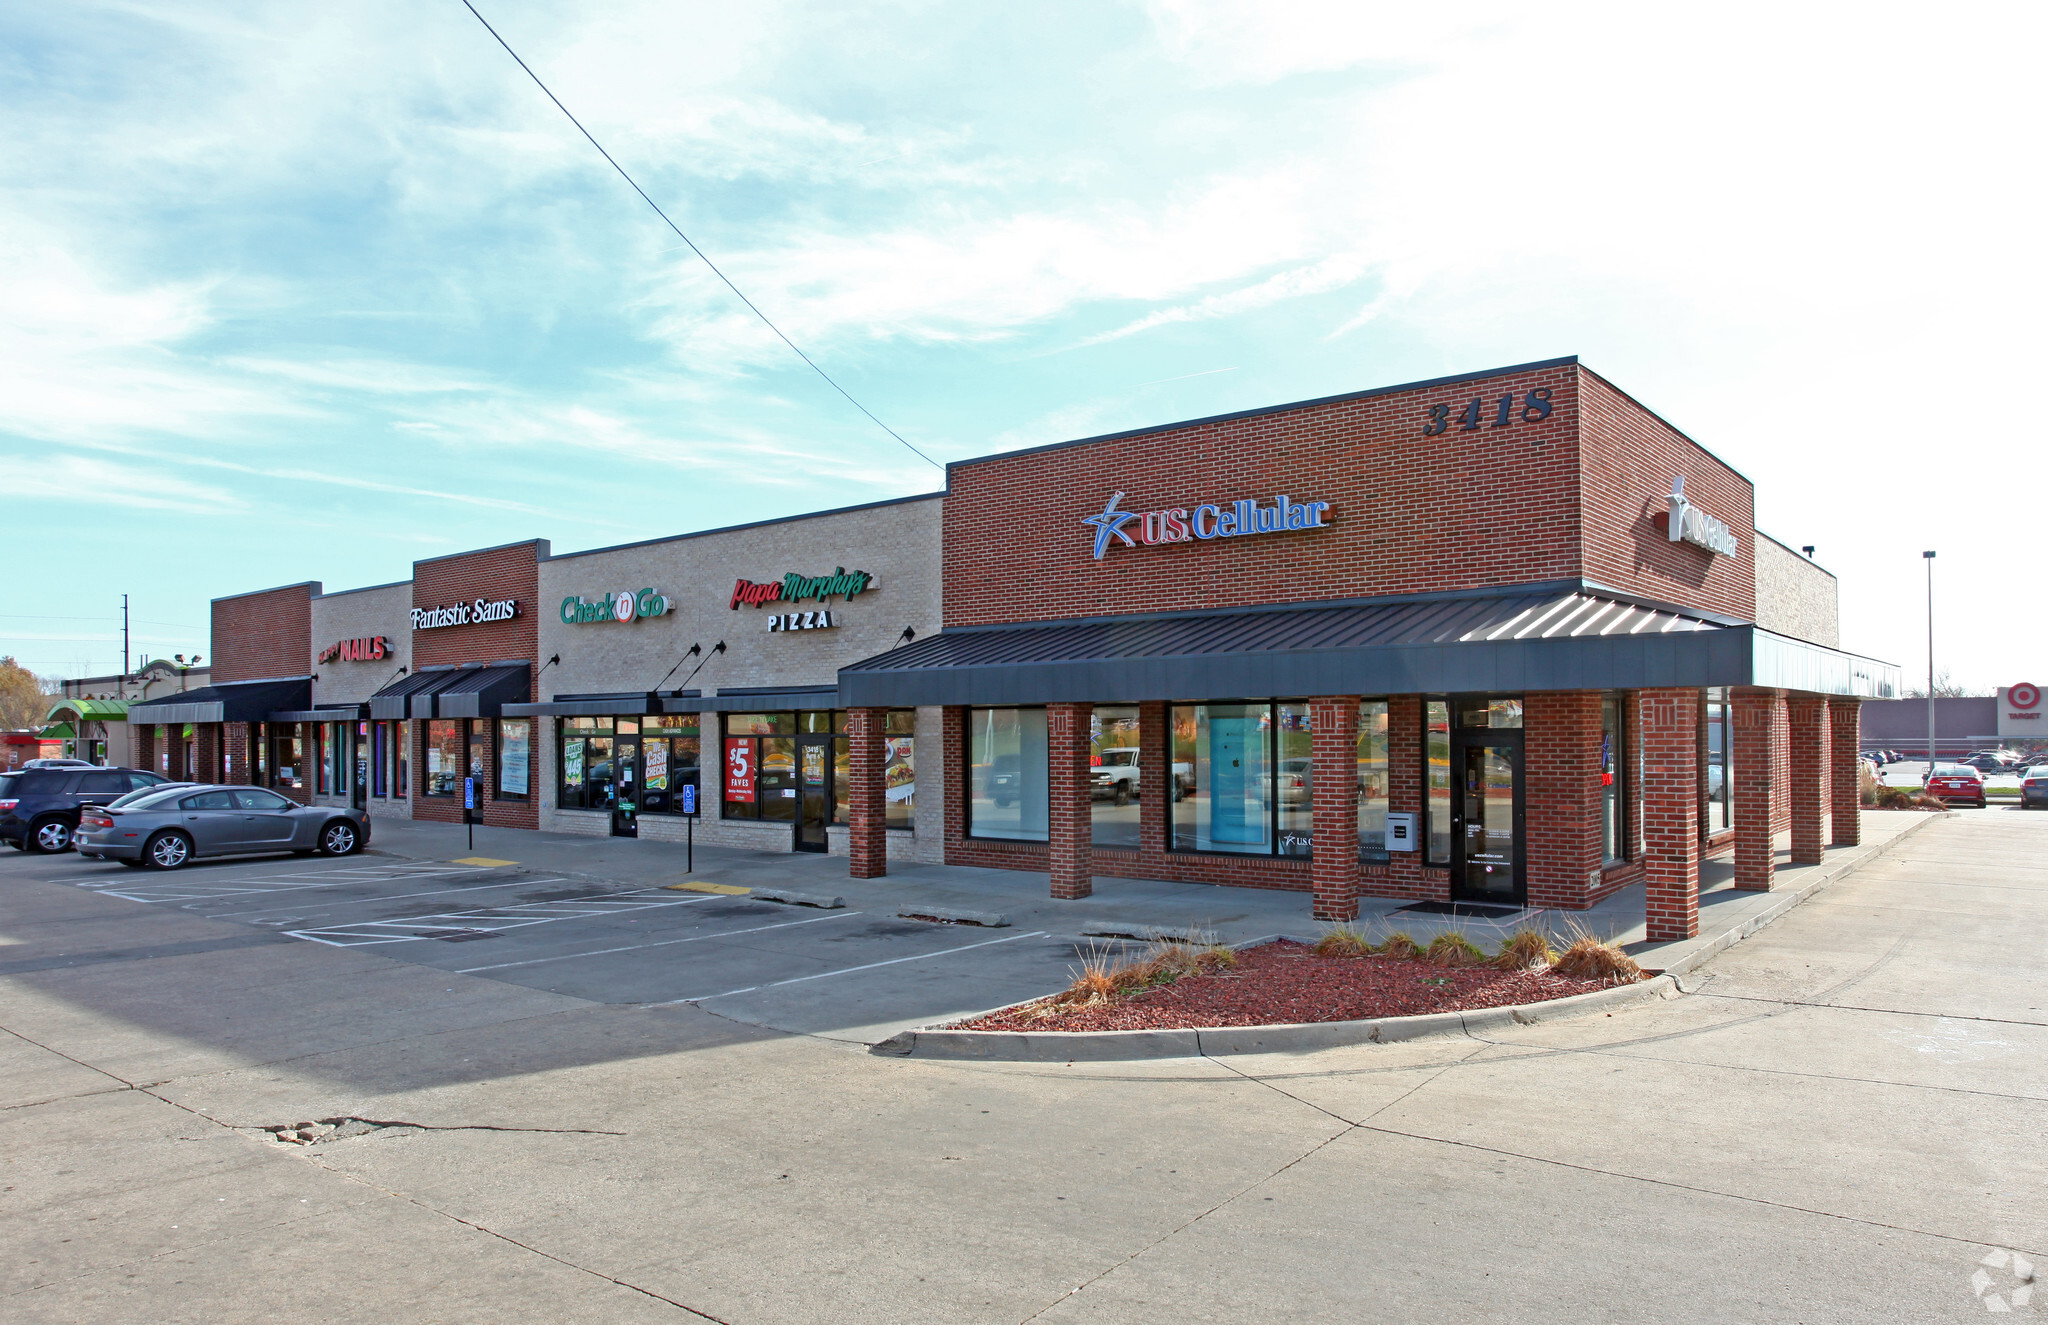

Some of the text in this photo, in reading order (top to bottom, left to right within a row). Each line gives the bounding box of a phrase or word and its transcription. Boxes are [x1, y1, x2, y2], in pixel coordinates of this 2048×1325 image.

[1423, 388, 1553, 436] 3418
[1140, 495, 1329, 545] U.S. Cellular
[730, 566, 868, 610] Papa Murphy's
[409, 599, 515, 630] Fantastic Sams
[560, 592, 614, 624] Check
[635, 587, 665, 617] Go
[767, 611, 831, 632] PIZZA
[340, 636, 385, 661] NAILS
[647, 748, 667, 766] Cash
[646, 765, 667, 778] CHECKS
[731, 779, 749, 787] FAVES
